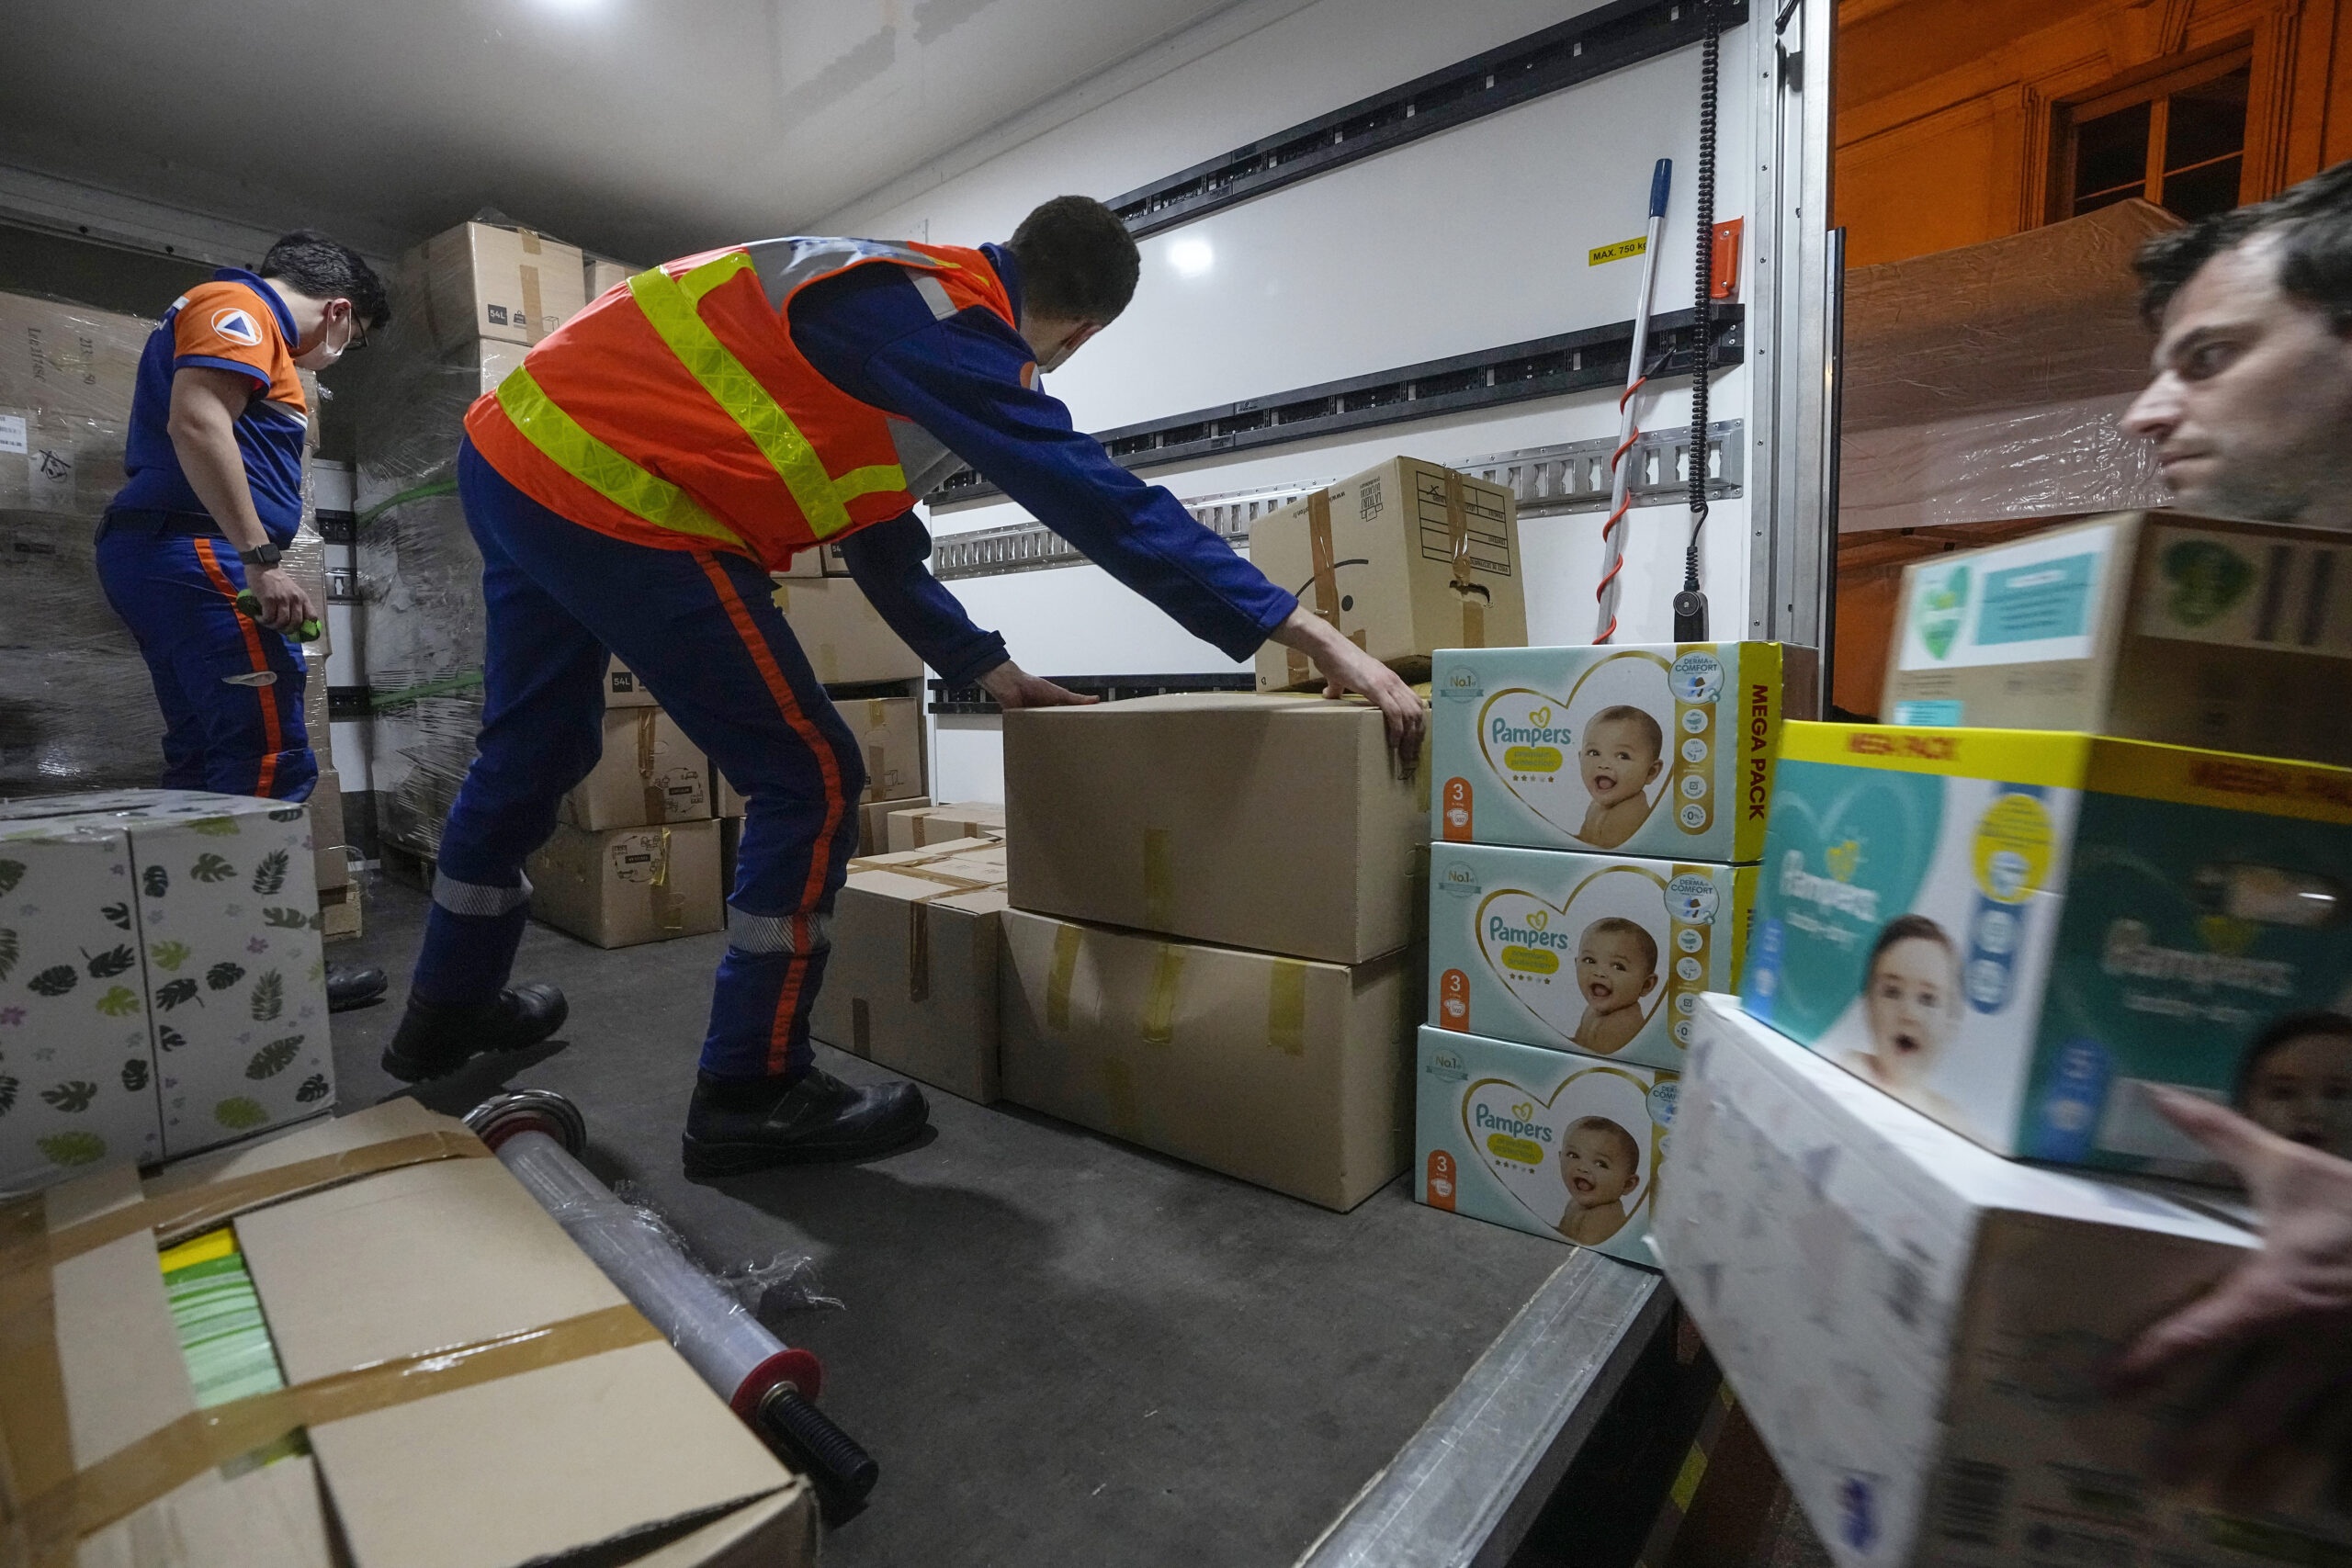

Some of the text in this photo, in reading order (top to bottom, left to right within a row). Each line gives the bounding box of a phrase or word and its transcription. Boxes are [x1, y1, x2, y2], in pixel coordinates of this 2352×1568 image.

[1593, 248, 1617, 261] MAX.
[1619, 243, 1634, 254] 750
[490, 310, 505, 320] 54L
[1675, 664, 1718, 672] COMFORT
[614, 677, 630, 686] 54L
[1492, 716, 1572, 748] Pampers
[1748, 684, 1769, 821] MEGA PACK
[1453, 783, 1464, 801] 3
[1670, 884, 1714, 896] COMFORT
[1489, 915, 1569, 951] Pampers
[1450, 975, 1461, 992] 3
[1476, 1102, 1553, 1143] Pampers
[1436, 1155, 1448, 1173] 3
